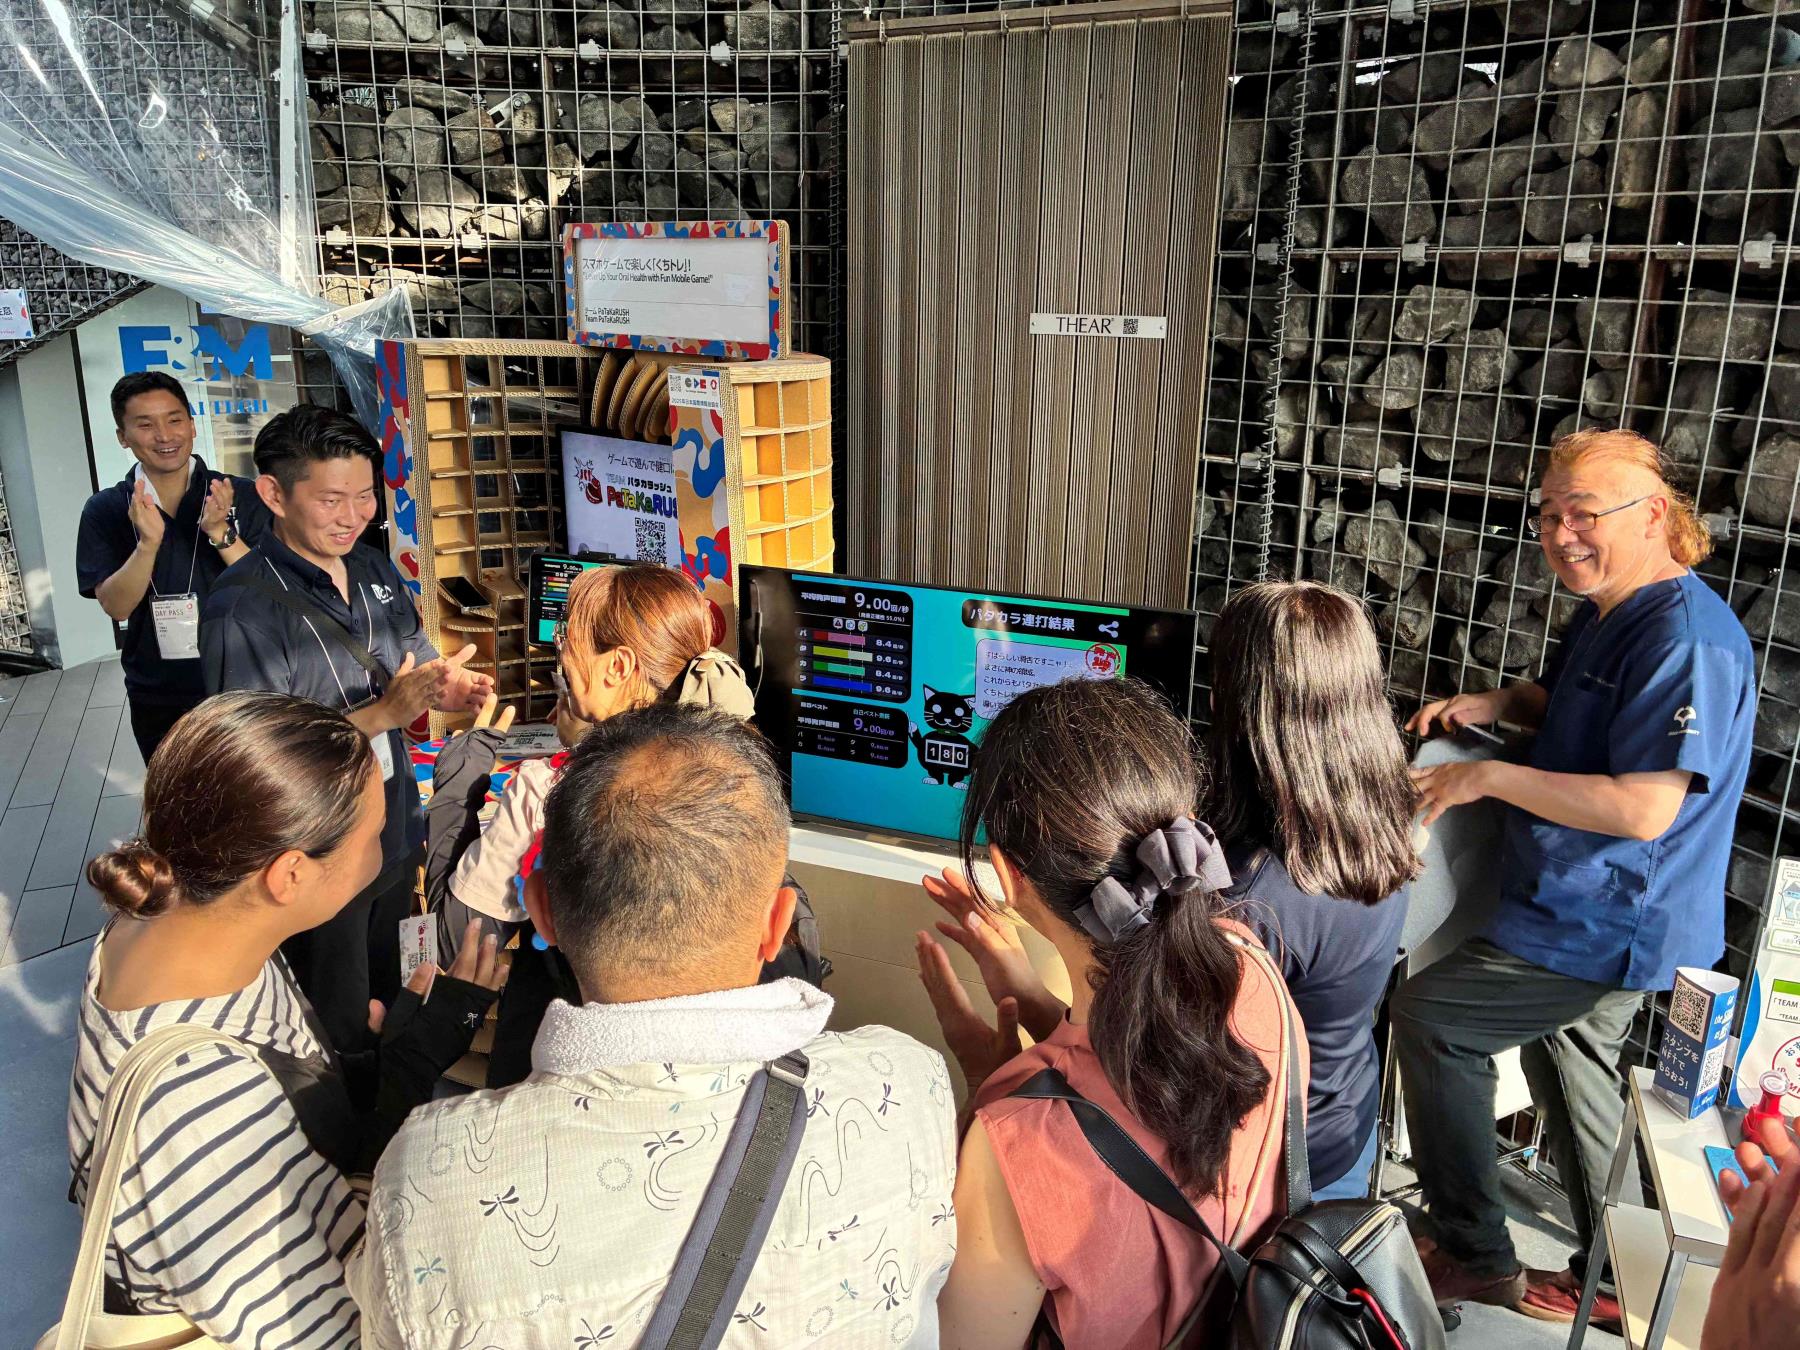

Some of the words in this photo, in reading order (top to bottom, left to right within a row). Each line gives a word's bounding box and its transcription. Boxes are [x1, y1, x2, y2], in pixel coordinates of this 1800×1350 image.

[618, 274, 629, 282] Oral
[630, 274, 647, 282] Health
[648, 274, 660, 282] with
[671, 274, 690, 283] Mobile
[585, 315, 598, 323] Team
[970, 608, 1075, 632] パタカラ連打結果
[1661, 1046, 1686, 1071] NFTで
[1664, 1030, 1700, 1064] スタンプを
[1658, 1062, 1688, 1090] もらおう!
